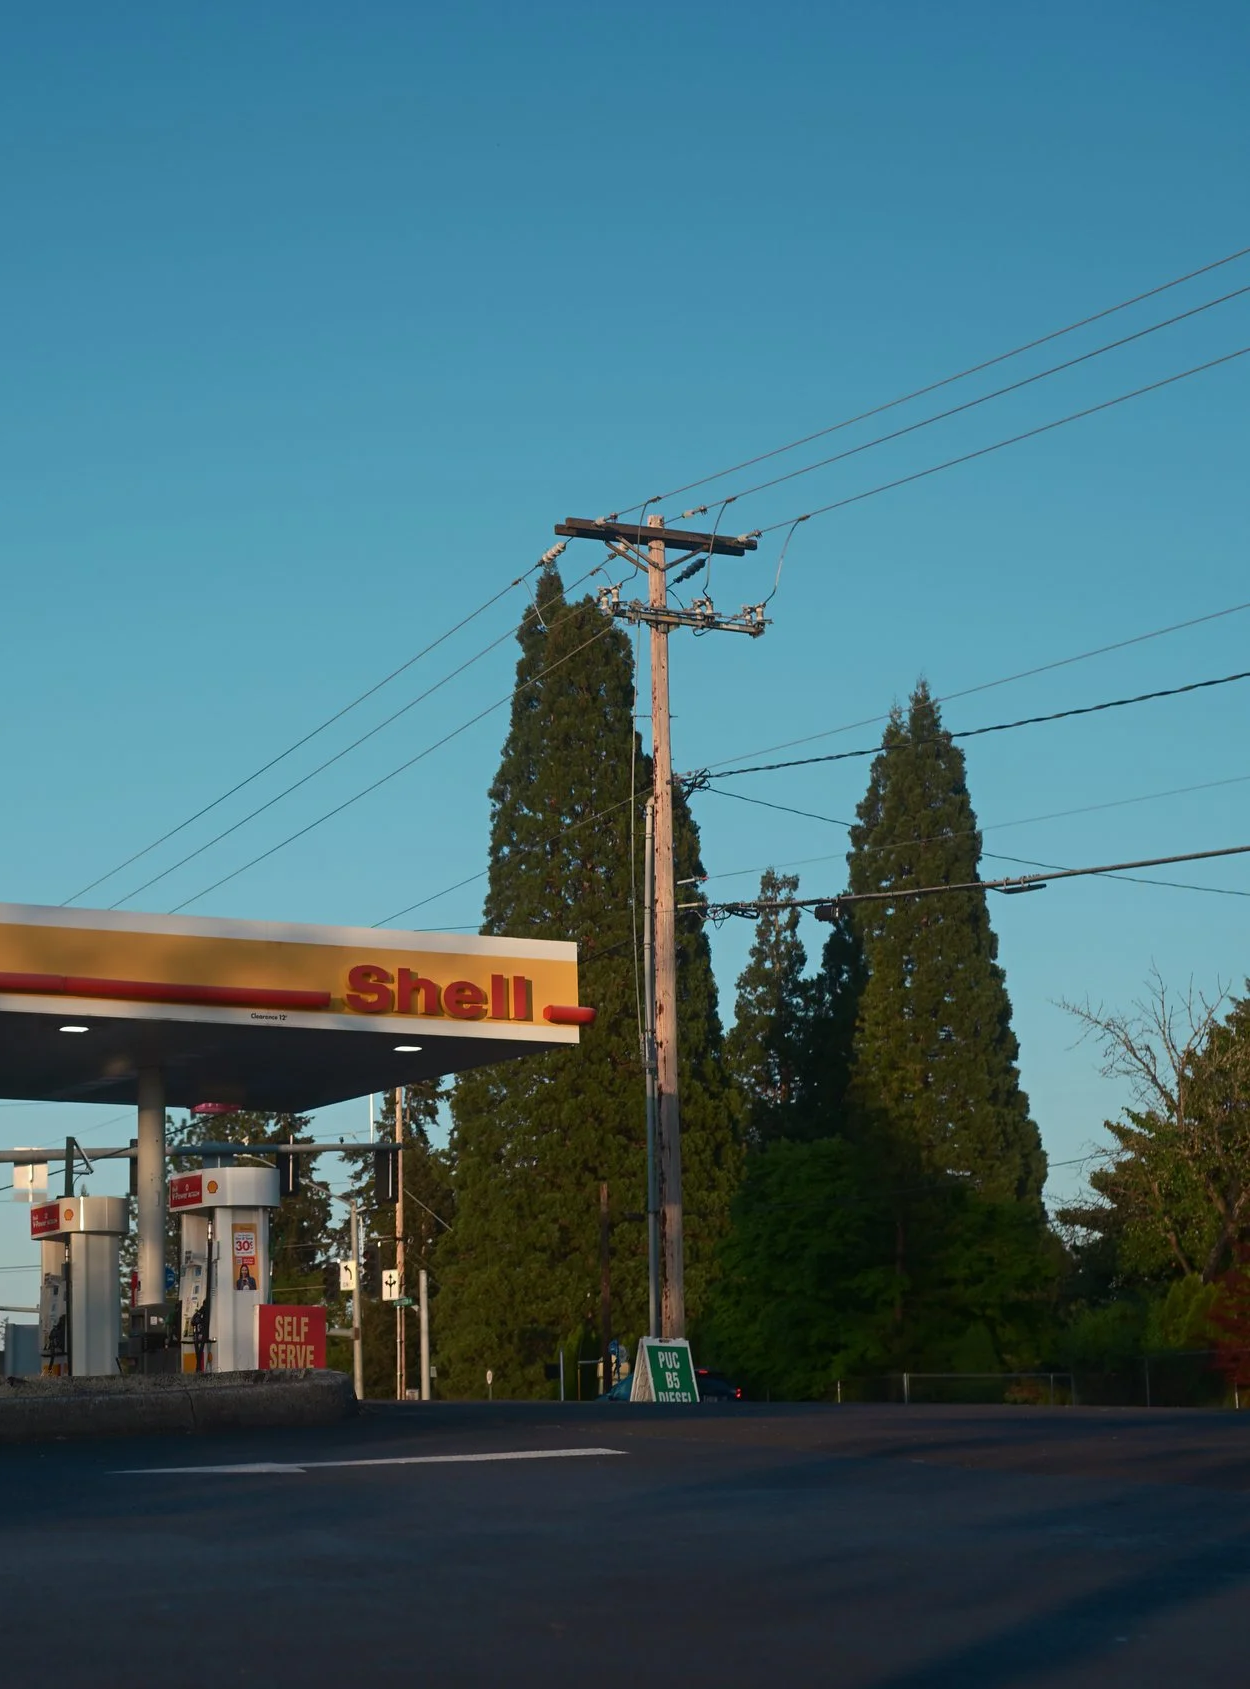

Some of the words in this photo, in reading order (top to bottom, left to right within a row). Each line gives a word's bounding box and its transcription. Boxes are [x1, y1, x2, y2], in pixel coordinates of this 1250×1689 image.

[346, 964, 532, 1022] Shell
[250, 1012, 278, 1021] Clearance
[274, 1315, 309, 1342] SELF
[269, 1343, 315, 1369] SERVE
[657, 1351, 681, 1370] PUC
[665, 1371, 681, 1389] B5
